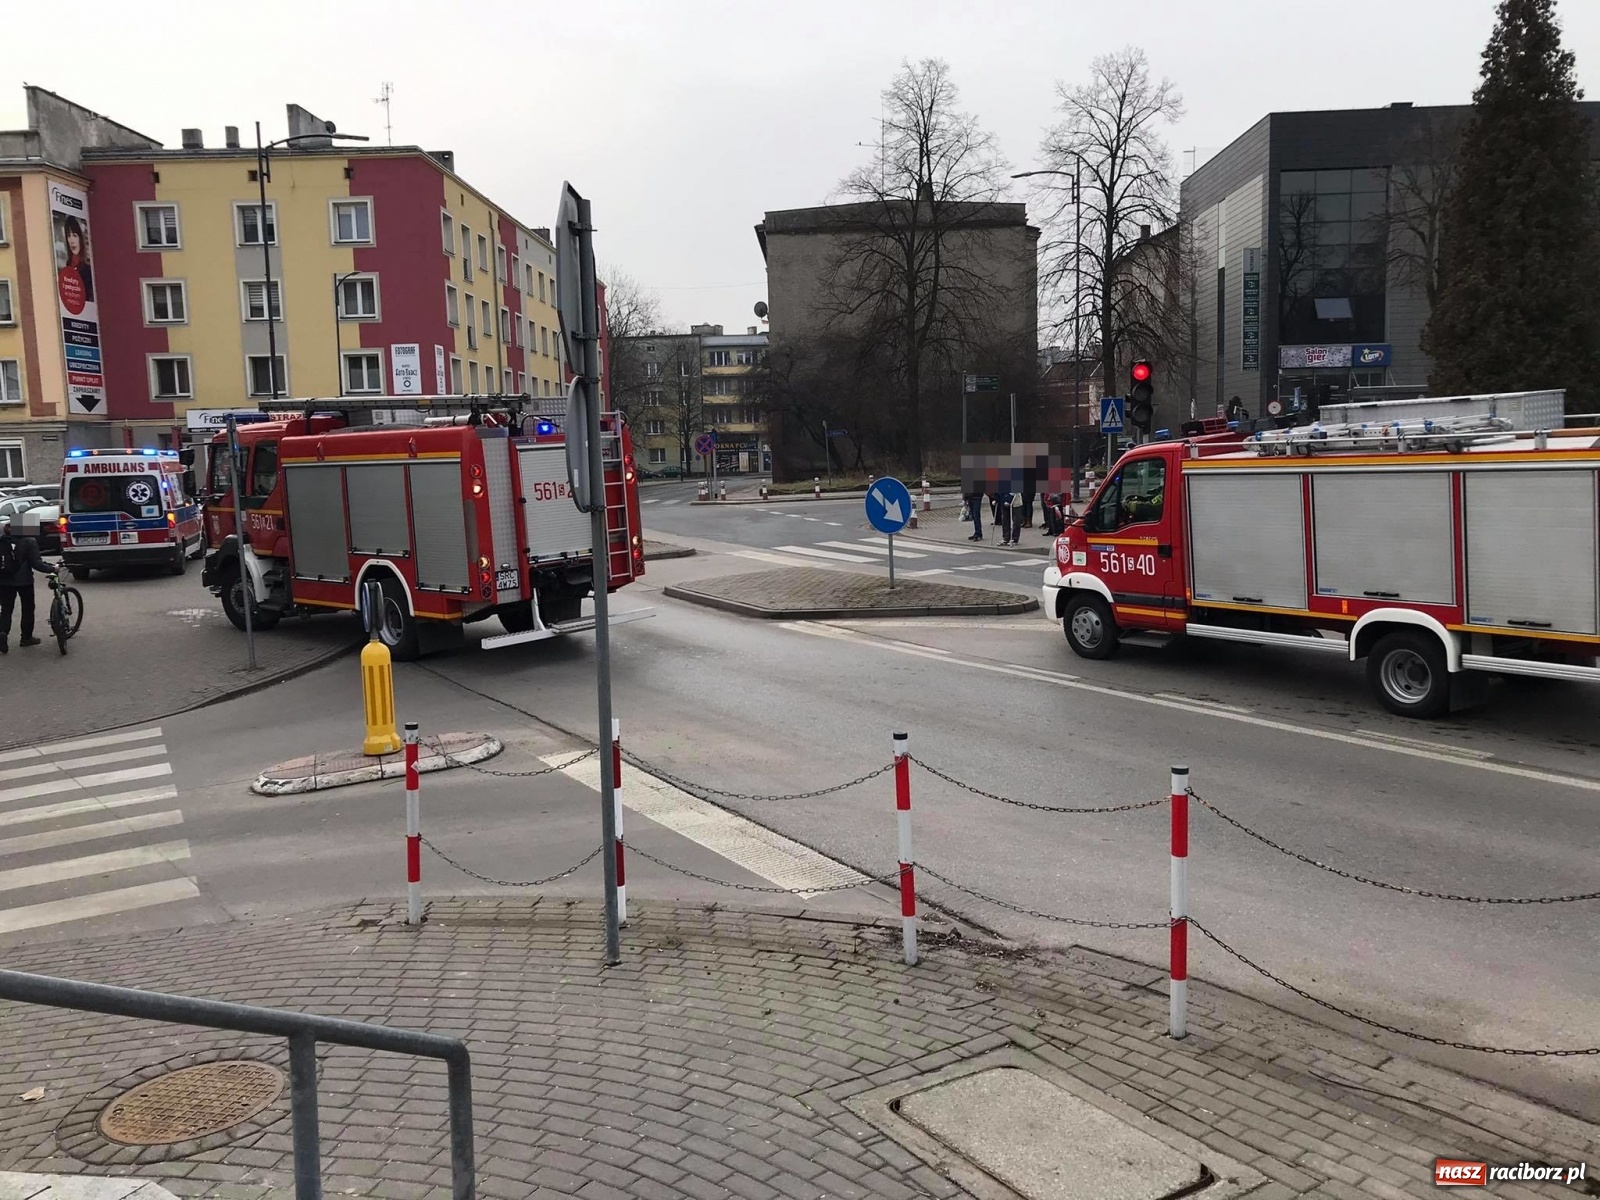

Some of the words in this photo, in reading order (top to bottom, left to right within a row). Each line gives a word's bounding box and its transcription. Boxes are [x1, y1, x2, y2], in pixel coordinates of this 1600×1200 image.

[1305, 347, 1328, 355] Salon
[1307, 353, 1326, 363] gier
[203, 415, 225, 424] Fine
[84, 462, 145, 474] AMBULANS
